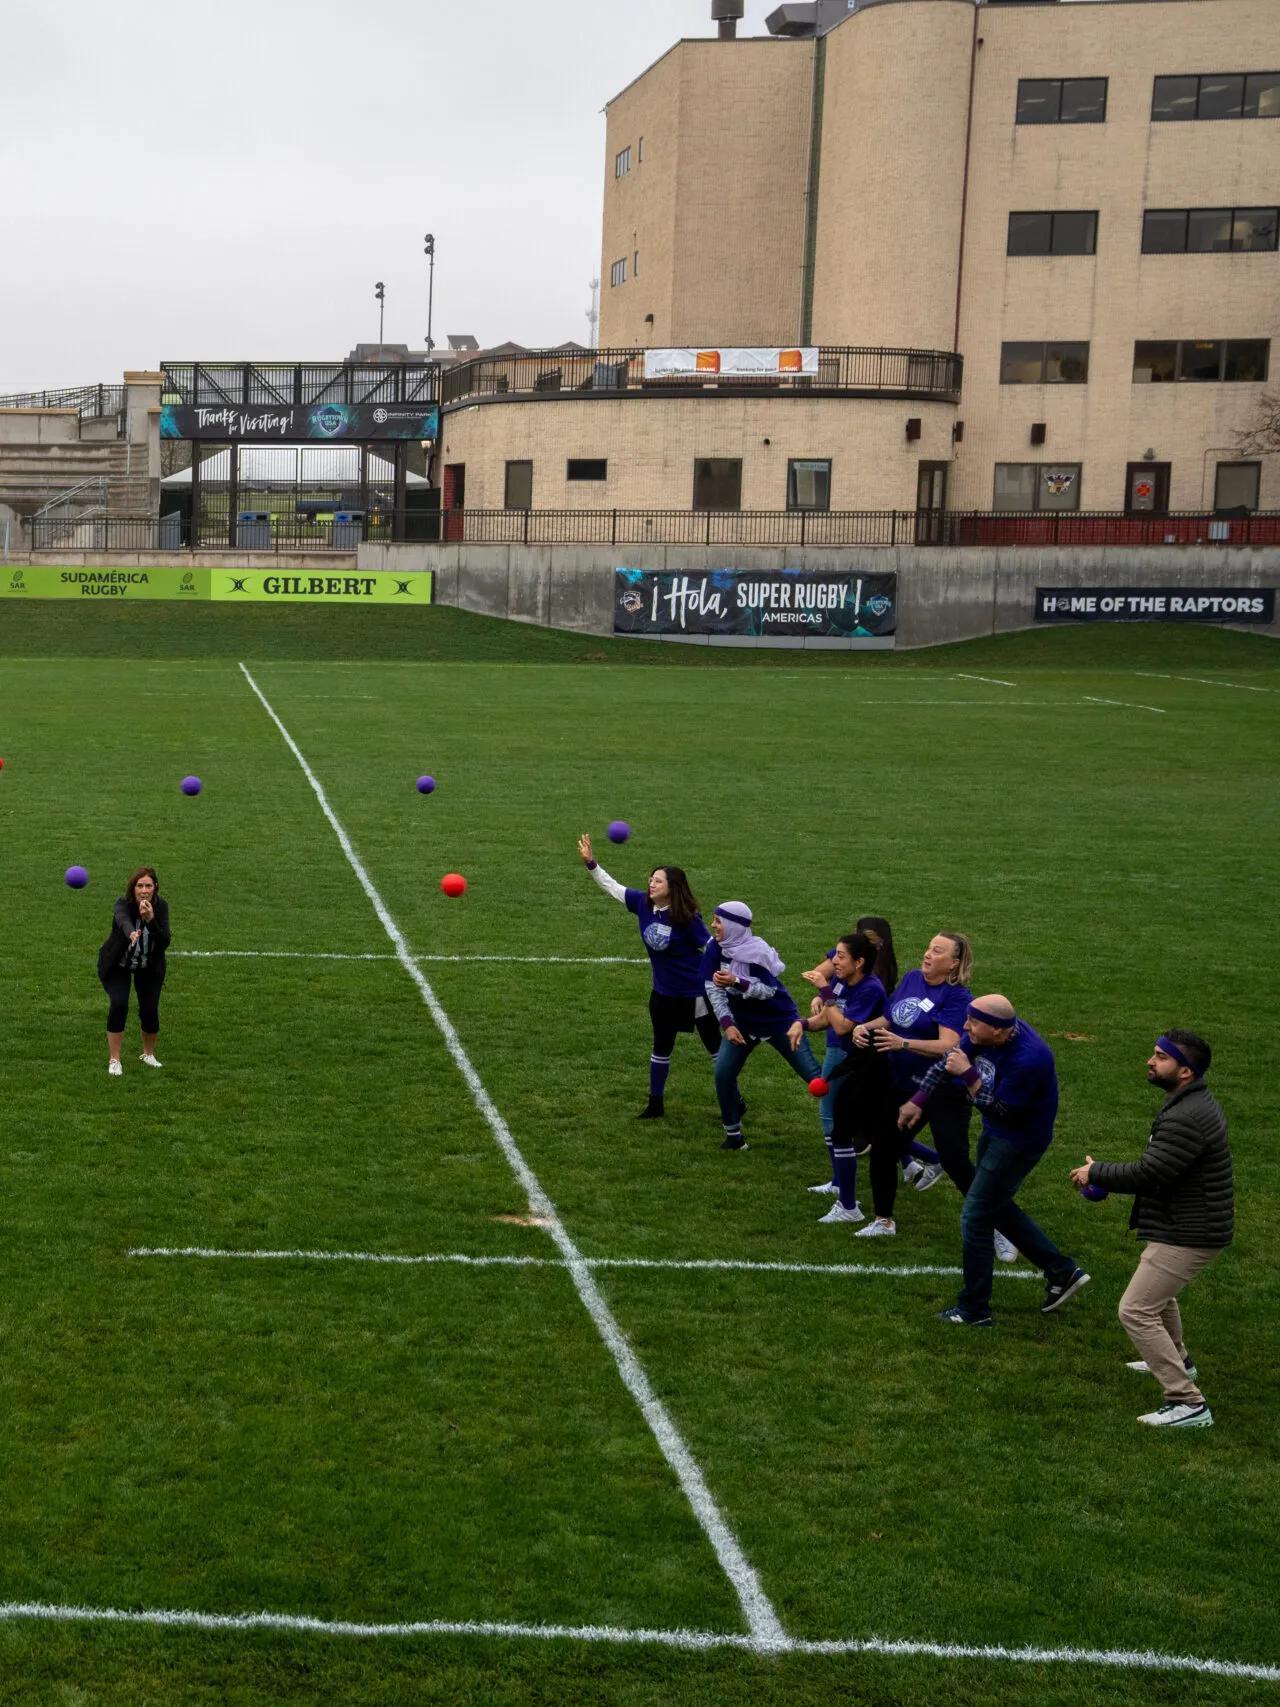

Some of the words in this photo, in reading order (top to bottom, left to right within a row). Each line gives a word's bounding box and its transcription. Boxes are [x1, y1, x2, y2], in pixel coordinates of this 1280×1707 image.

[194, 408, 239, 429] Thanks
[228, 424, 238, 435] for
[60, 570, 149, 583] SUDAMÉRICA
[81, 585, 127, 595] RUGBY
[264, 577, 376, 595] GILBERT
[737, 582, 790, 608] SUPER
[1100, 597, 1125, 612] OF
[1128, 597, 1165, 612] THE
[1170, 598, 1264, 613] RAPTORS
[762, 612, 822, 623] AMERICAS
